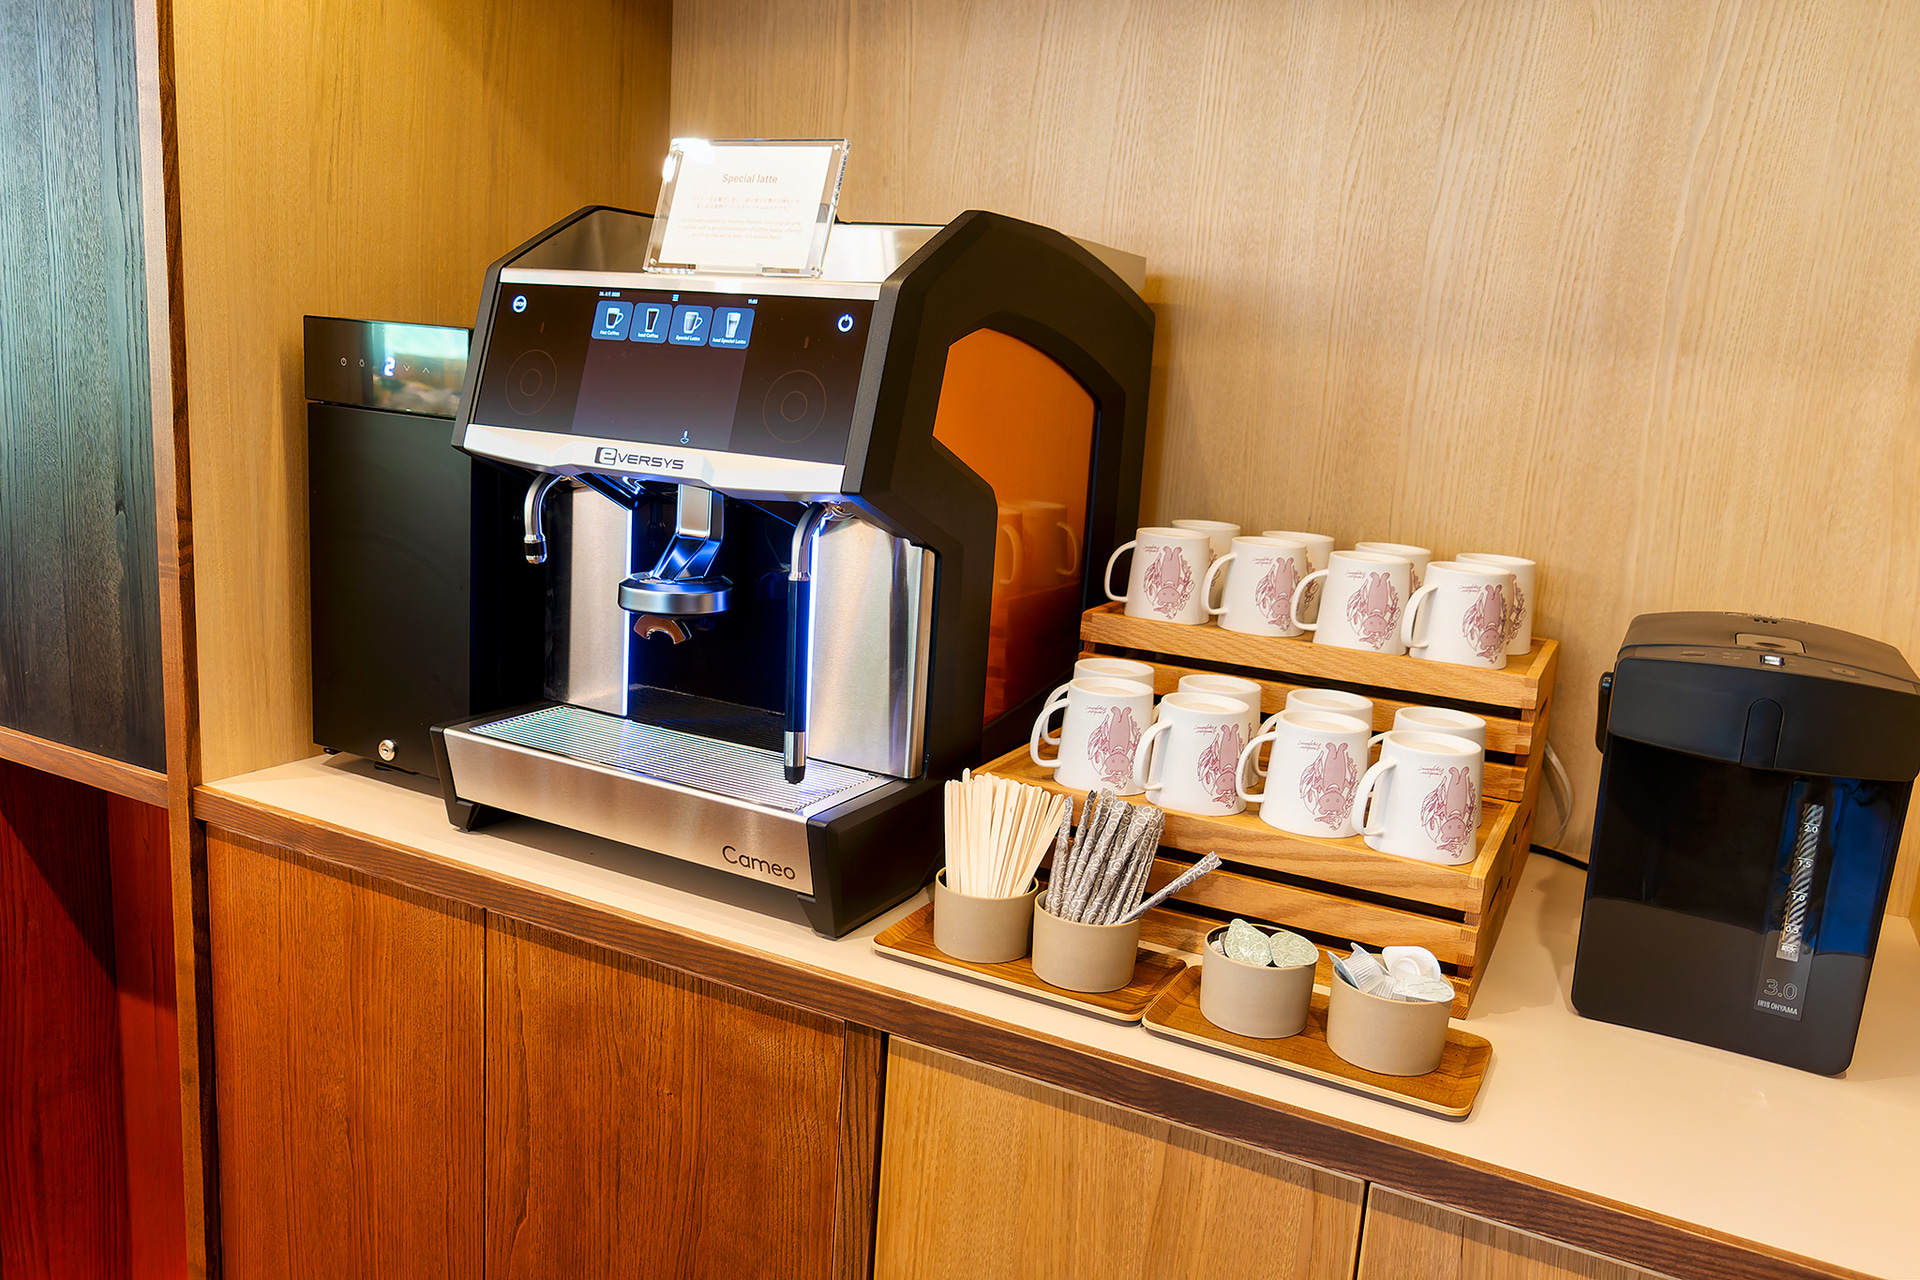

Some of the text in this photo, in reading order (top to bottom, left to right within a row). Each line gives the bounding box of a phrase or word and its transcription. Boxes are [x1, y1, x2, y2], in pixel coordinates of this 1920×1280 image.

[722, 173, 778, 185] Special latte
[384, 357, 396, 377] 2
[1804, 824, 1818, 834] 2.0
[722, 845, 796, 880] Cameo
[1798, 859, 1812, 868] 1.5
[1792, 893, 1806, 902] 1.0
[1785, 925, 1799, 934] 0.5
[1764, 978, 1798, 1000] 3.0
[1771, 1002, 1798, 1015] OHYAMA
